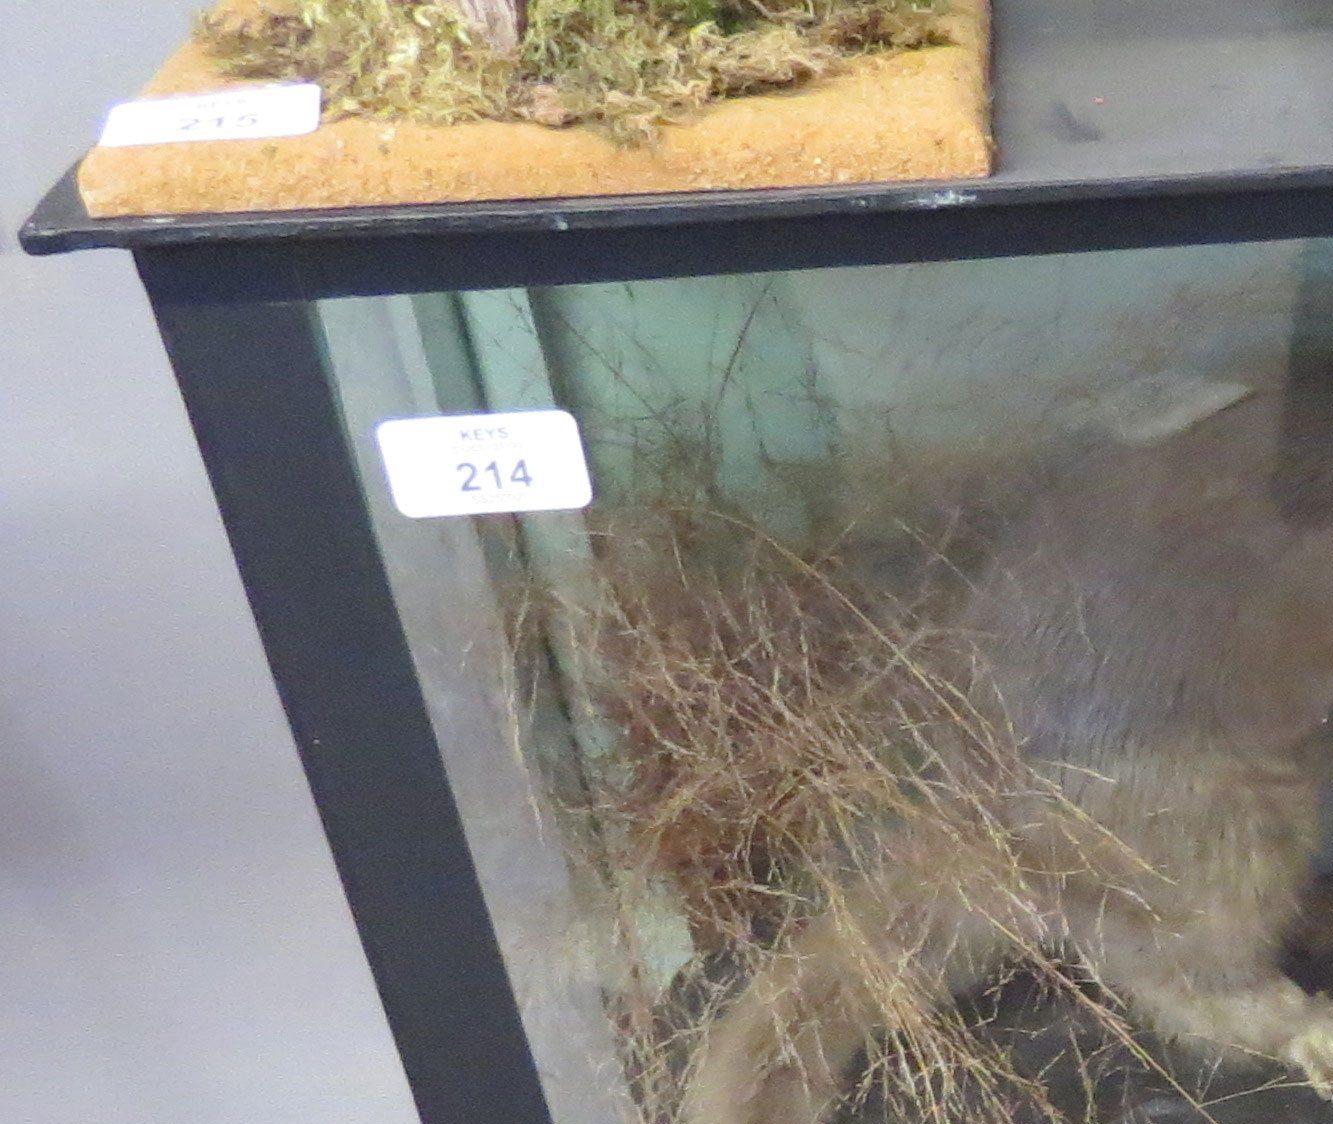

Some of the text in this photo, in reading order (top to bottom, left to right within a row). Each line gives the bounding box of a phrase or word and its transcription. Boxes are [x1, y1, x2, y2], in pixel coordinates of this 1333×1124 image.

[178, 113, 259, 131] 215
[459, 426, 510, 441] KEYS
[456, 458, 533, 492] 214
